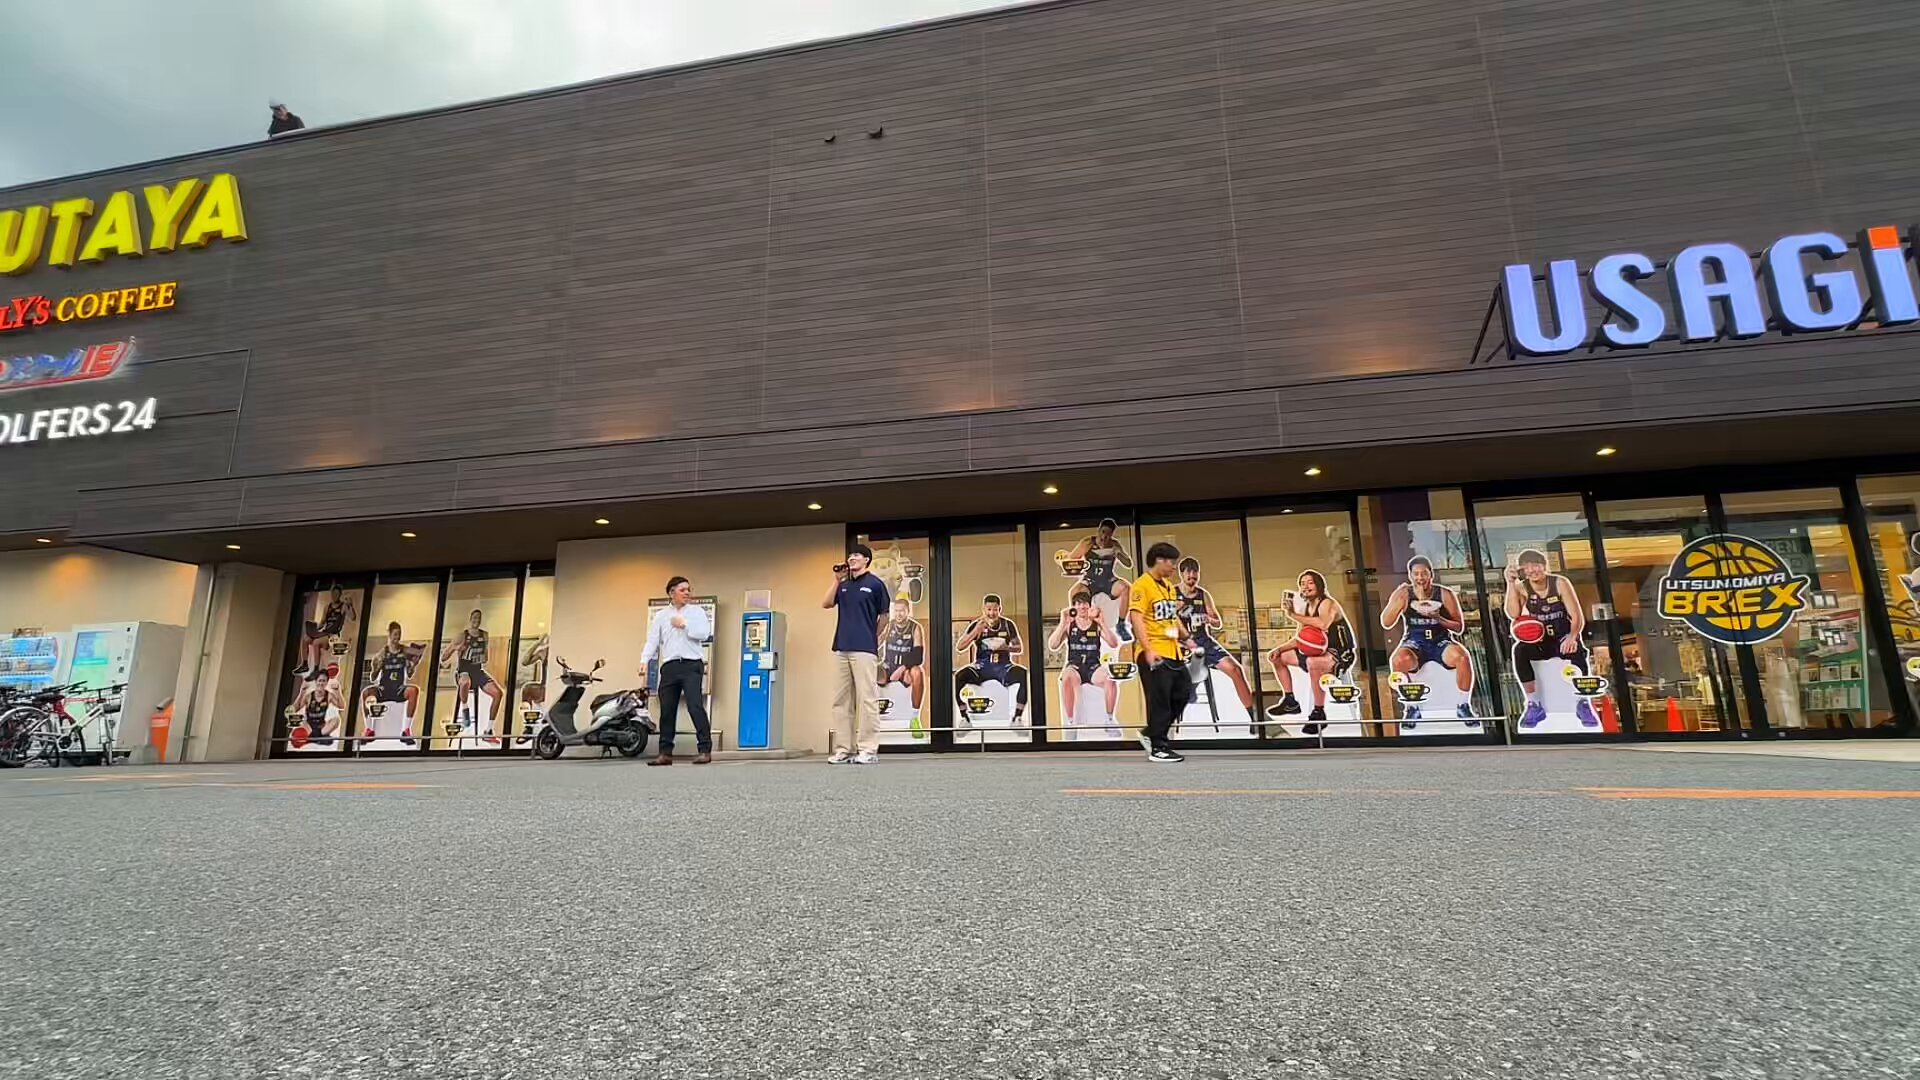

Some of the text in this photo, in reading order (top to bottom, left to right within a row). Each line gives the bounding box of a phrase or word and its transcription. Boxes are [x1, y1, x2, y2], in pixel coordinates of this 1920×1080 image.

[0, 173, 247, 276] UTAYA
[56, 281, 177, 322] COFFEE
[1664, 580, 1805, 615] BREX
[1665, 572, 1786, 590] UTSUNOMIYA
